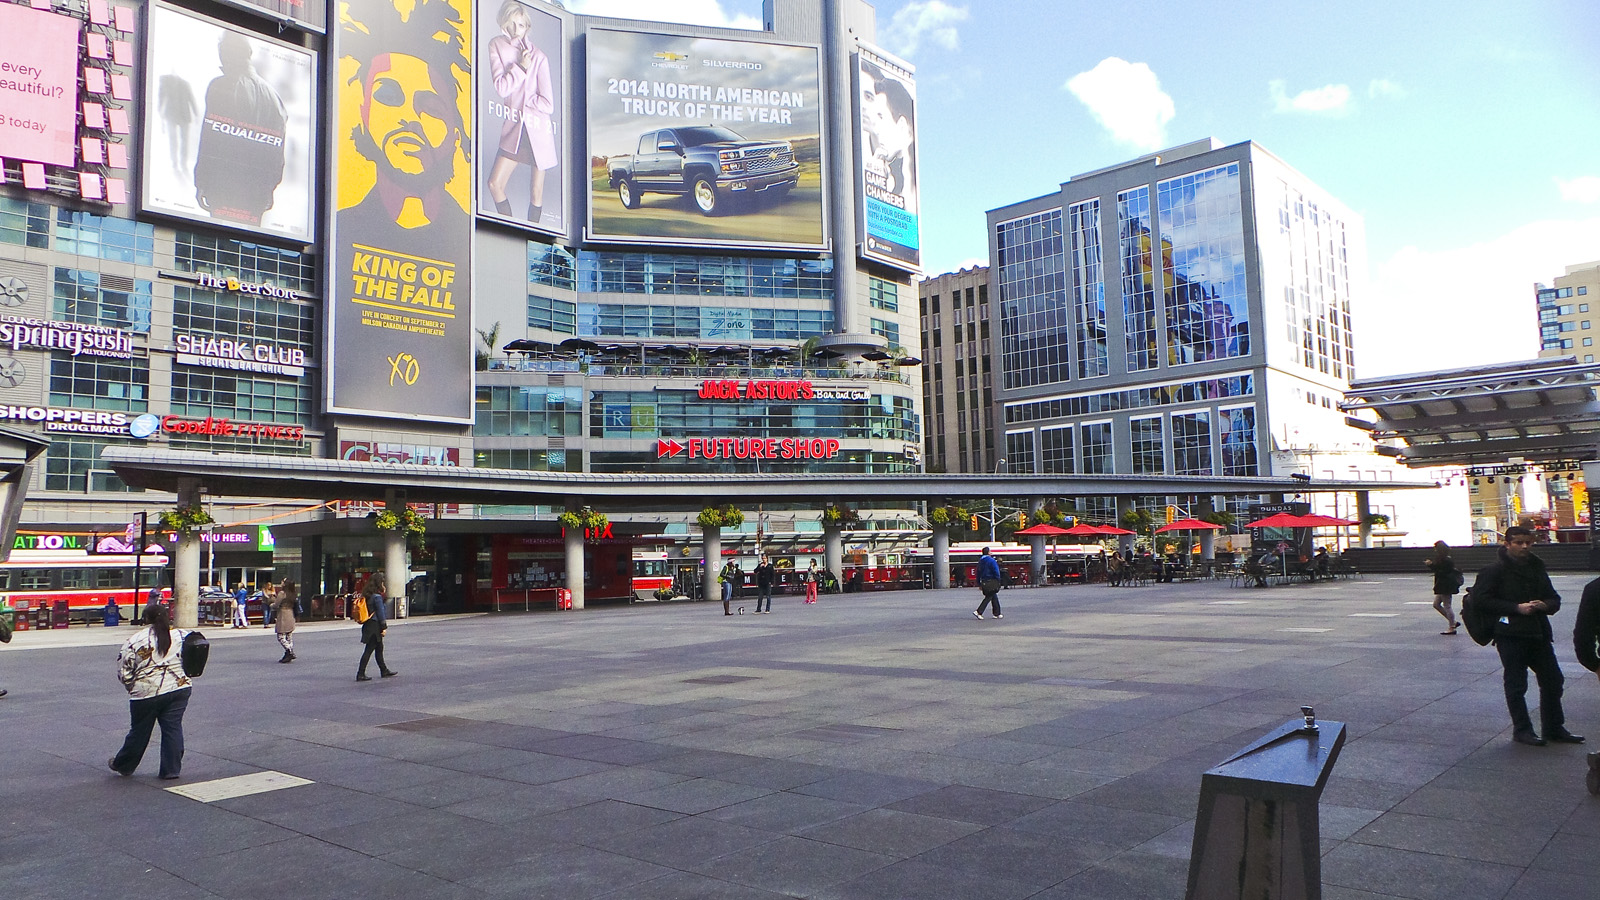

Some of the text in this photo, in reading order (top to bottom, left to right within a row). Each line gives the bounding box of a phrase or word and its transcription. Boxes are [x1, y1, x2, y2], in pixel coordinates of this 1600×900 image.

[2, 62, 42, 80] every
[702, 59, 762, 70] SILVERADO
[608, 78, 804, 108] 2014 NORTH AMERICAN
[488, 100, 540, 128] FOREVER
[621, 97, 792, 124] TRUCK OF THE YEAR
[9, 117, 46, 133] today
[212, 122, 282, 146] EQUALIZER
[866, 171, 887, 189] GAME
[866, 184, 904, 209] CHANGERS
[868, 201, 912, 223] WORK YOUR DEGREE
[868, 210, 879, 220] WITH
[352, 252, 455, 288] KING OF
[196, 272, 298, 299] The Beer Store
[352, 274, 455, 310] THE FALL
[1, 314, 116, 335] LOUNGE RESTAURANT
[362, 318, 445, 336] MOLSON CANADIAN AMPHITHEATRE
[380, 313, 402, 322] CONCERT
[411, 318, 439, 328] SEPTEMBER
[708, 318, 745, 337] Zone
[176, 334, 304, 366] SHARK CLUB
[200, 356, 284, 374] SPORTS BAR GRILL
[387, 352, 420, 387] XO
[698, 380, 814, 400] JACK ASTOR'S
[817, 390, 871, 400] Bar and Grill
[0, 405, 127, 425] SHOPPERS
[48, 422, 128, 434] DRUG MART
[162, 415, 303, 440] GoodLife FITNESS
[688, 438, 839, 459] FUTURE SHOP
[222, 534, 250, 542] HERE.
